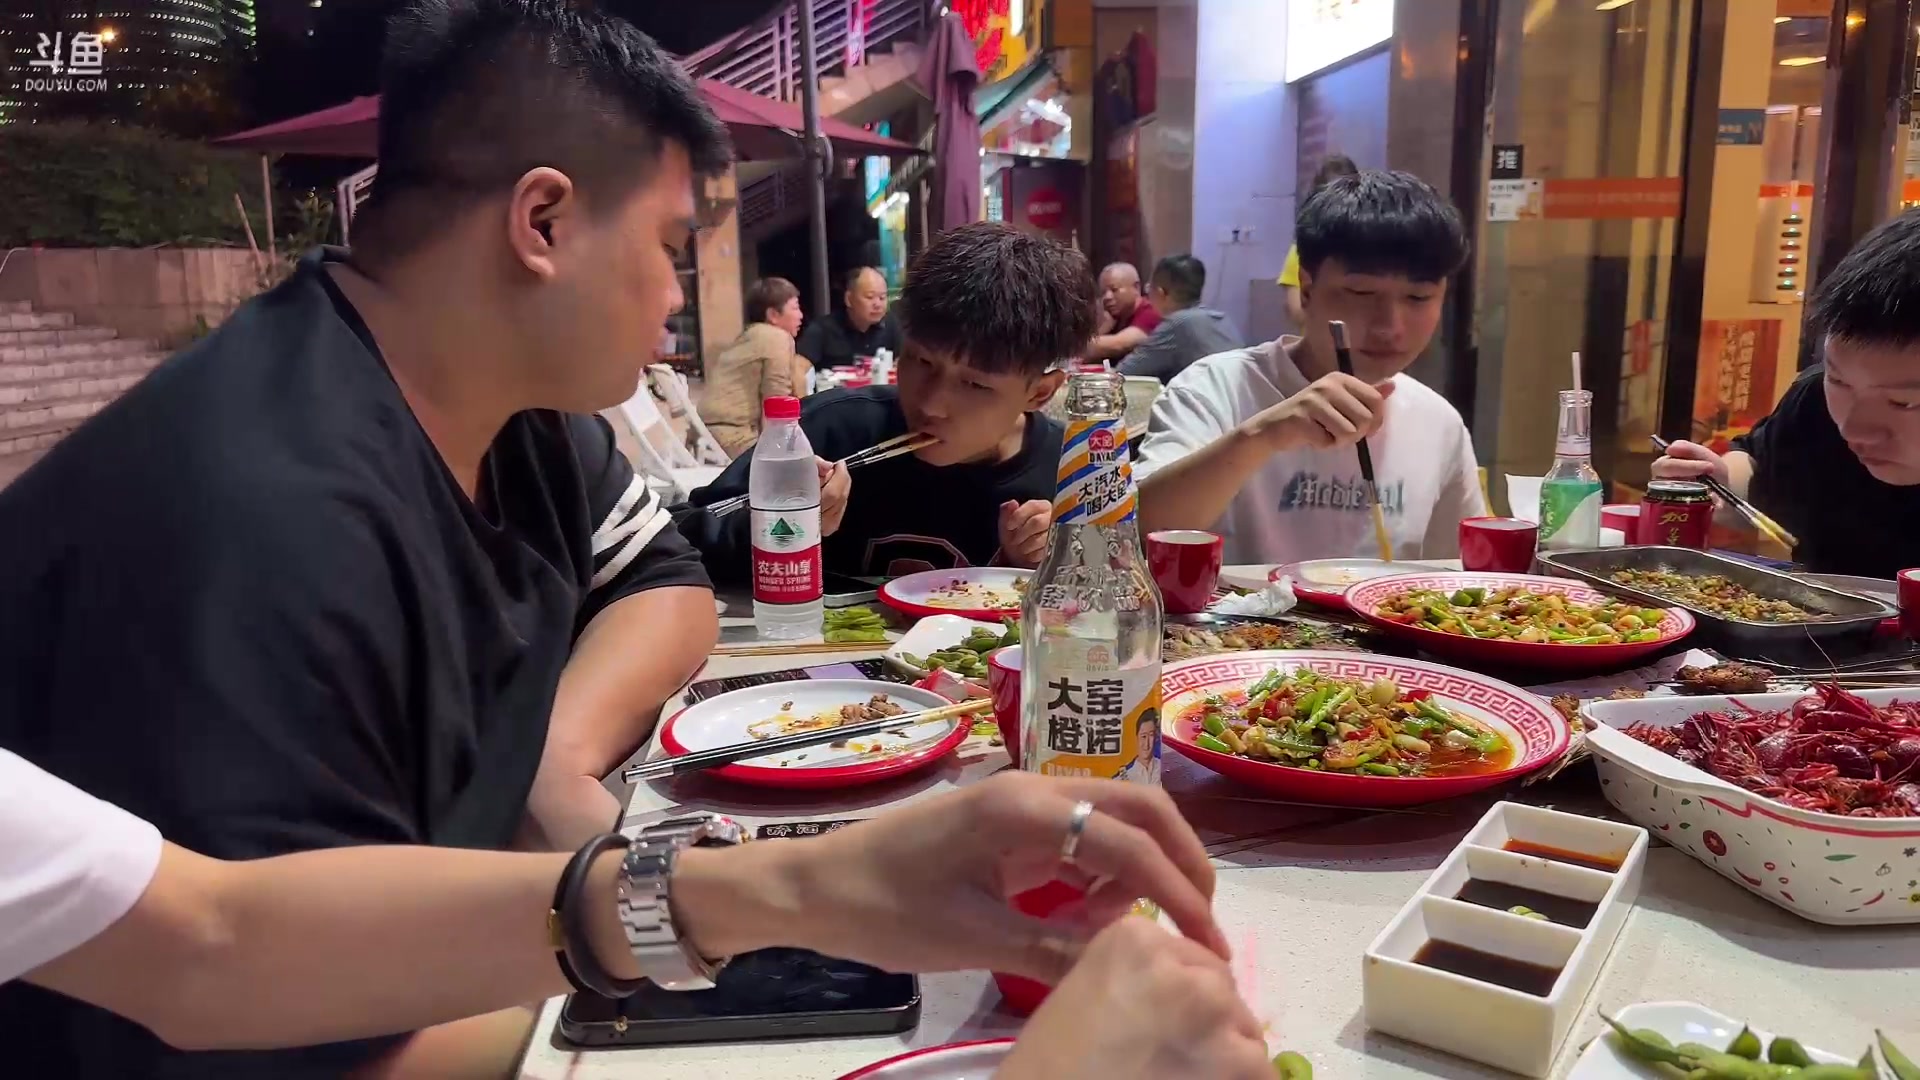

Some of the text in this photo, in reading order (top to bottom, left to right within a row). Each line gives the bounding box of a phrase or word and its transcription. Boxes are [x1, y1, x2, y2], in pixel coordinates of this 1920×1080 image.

[1496, 151, 1518, 170] 推
[1078, 465, 1121, 502] 大汽水
[757, 559, 812, 577] 农夫山泉
[1047, 714, 1122, 755] 橙诺
